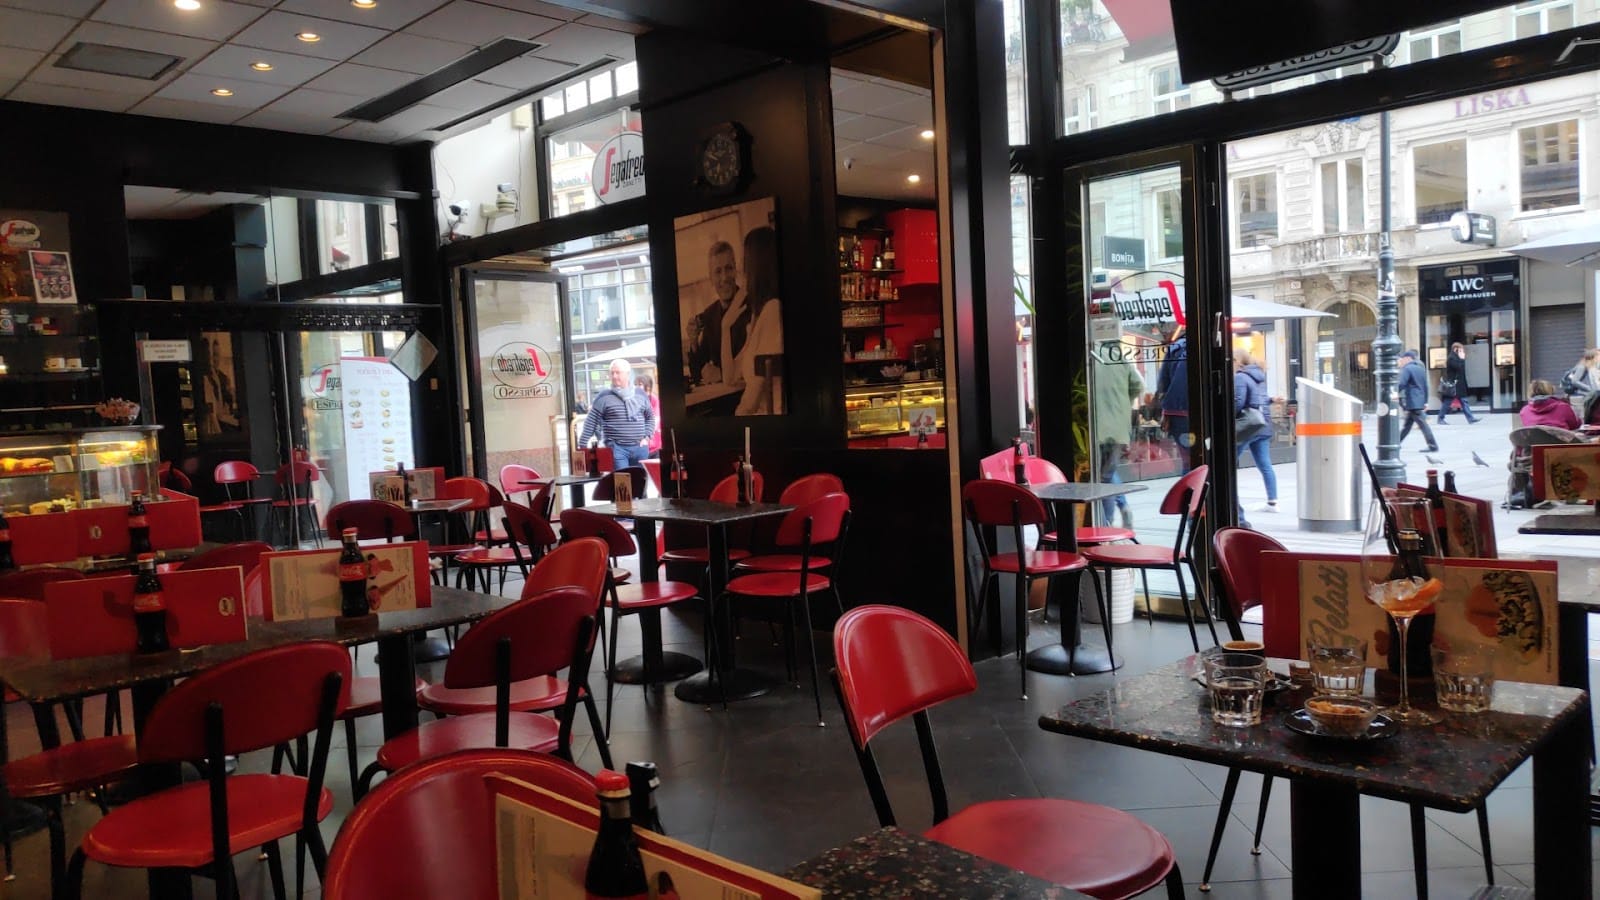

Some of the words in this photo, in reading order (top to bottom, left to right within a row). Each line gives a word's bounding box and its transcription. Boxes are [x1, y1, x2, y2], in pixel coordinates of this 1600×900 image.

[1455, 86, 1531, 118] LISKA
[1111, 251, 1135, 265] BONITA
[1452, 277, 1484, 292] IWC
[1440, 291, 1496, 301] SCHAFFHAUSEN
